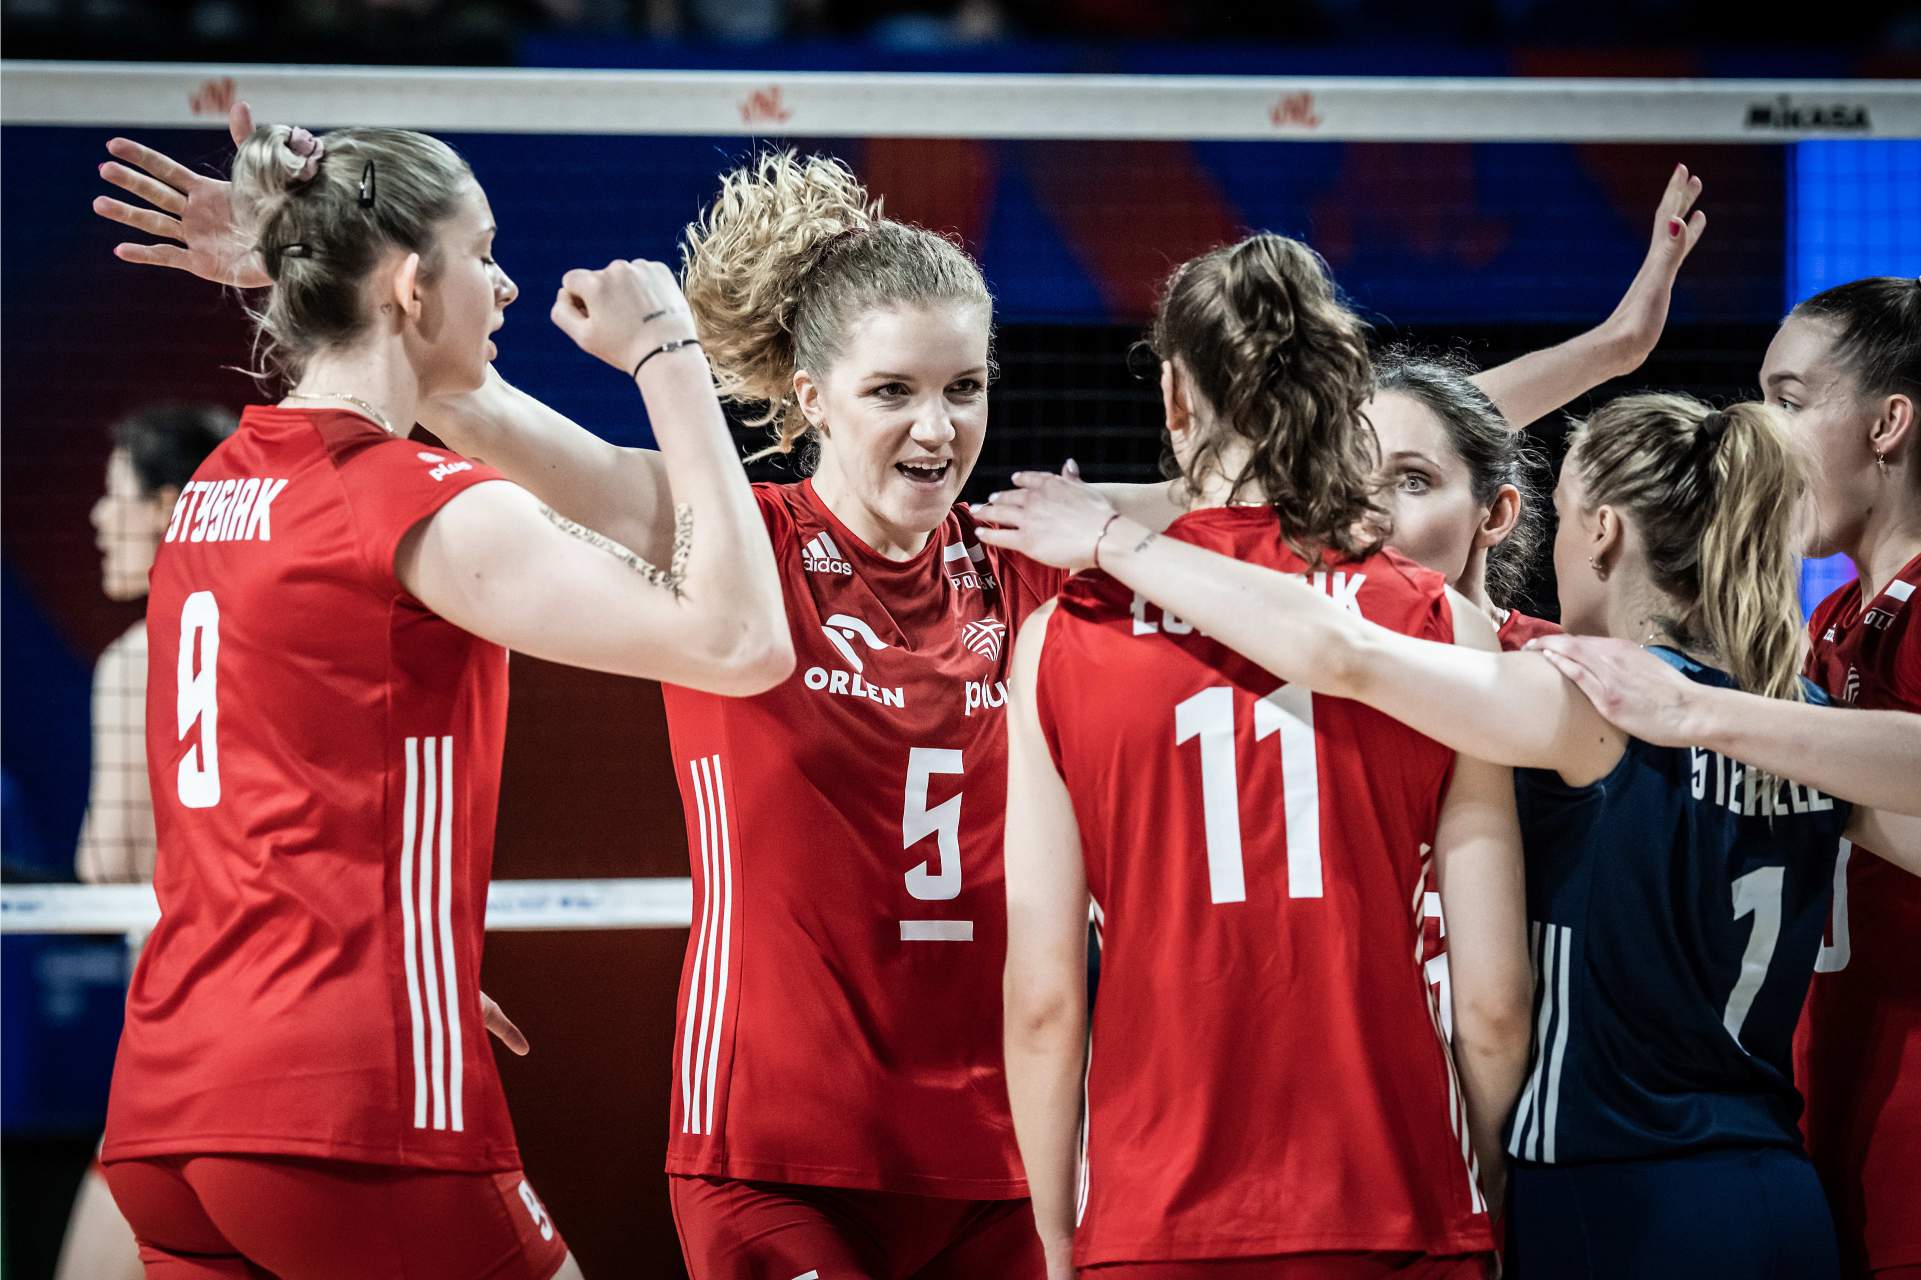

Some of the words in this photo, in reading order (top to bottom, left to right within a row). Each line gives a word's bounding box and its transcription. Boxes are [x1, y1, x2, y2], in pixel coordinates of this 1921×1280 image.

[165, 478, 288, 543] STYSIAK
[177, 590, 221, 809] 9
[804, 666, 905, 708] ORLEN
[964, 673, 1010, 717] plu
[902, 746, 965, 900] 5
[1175, 683, 1324, 904] 11
